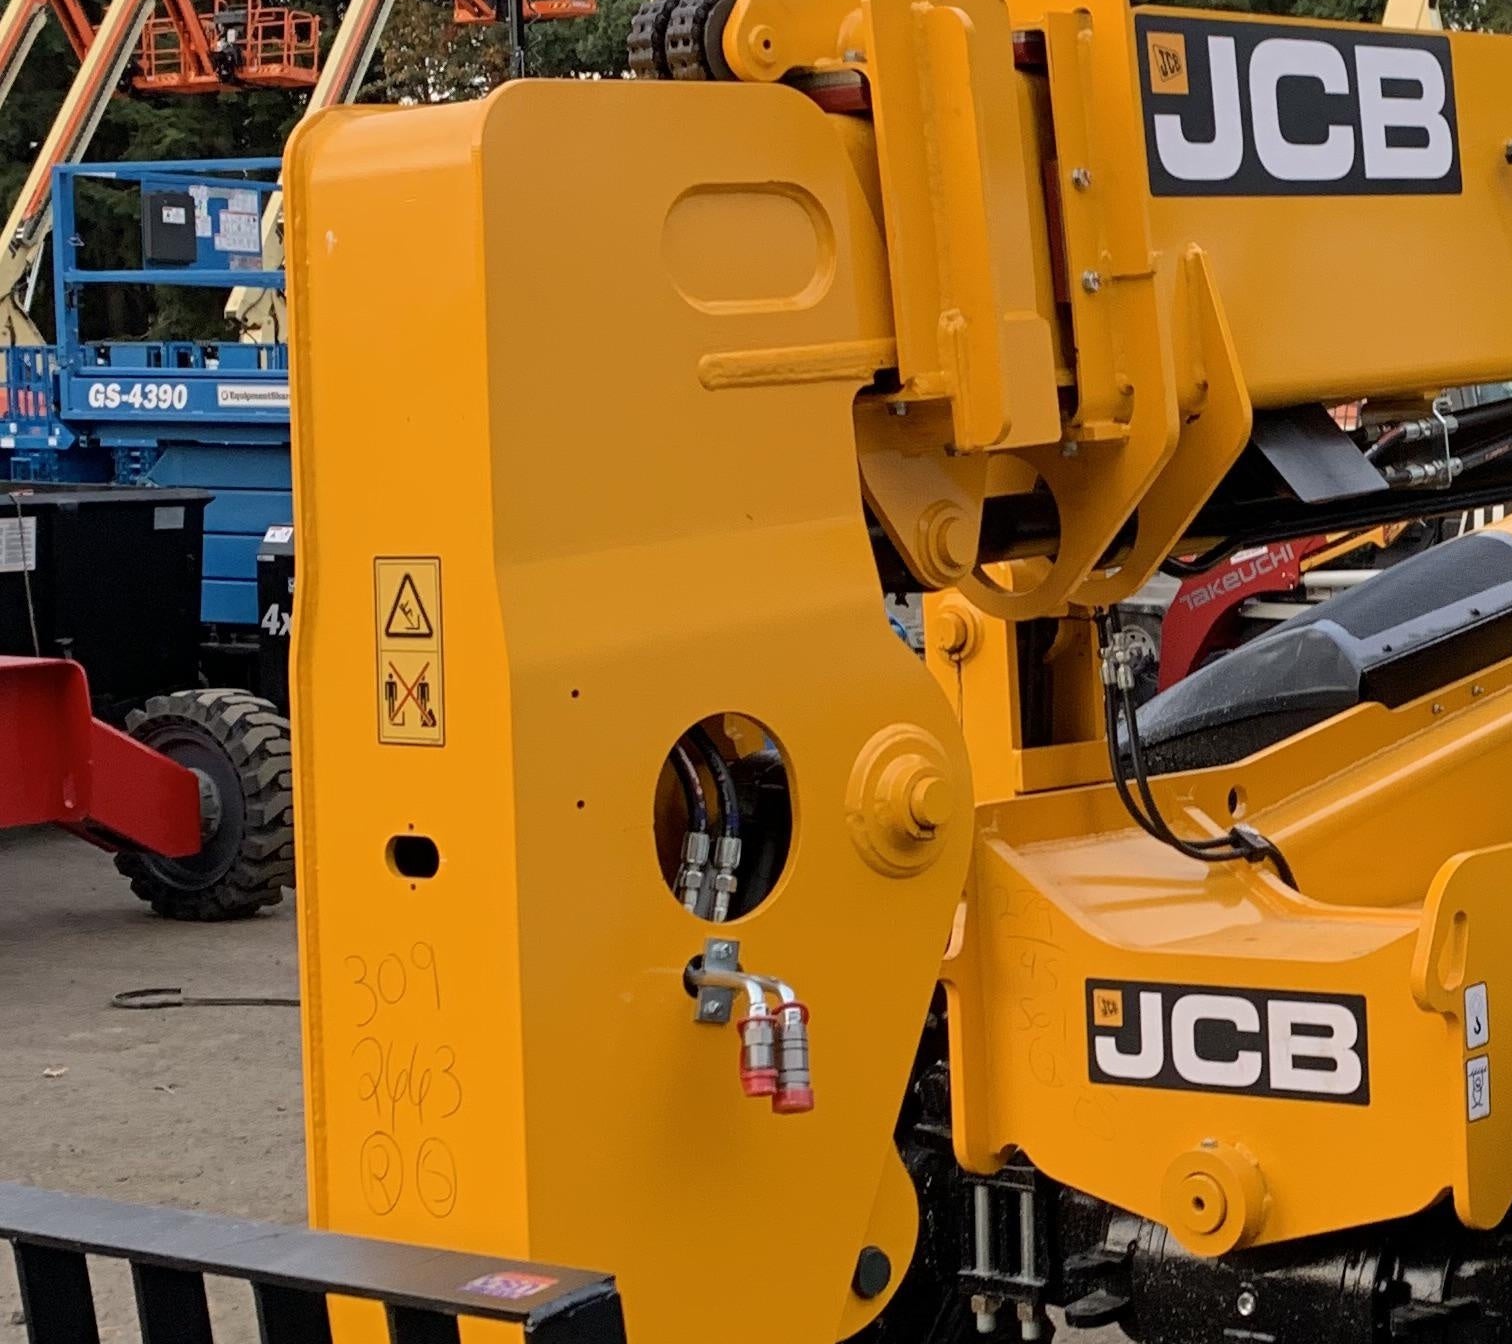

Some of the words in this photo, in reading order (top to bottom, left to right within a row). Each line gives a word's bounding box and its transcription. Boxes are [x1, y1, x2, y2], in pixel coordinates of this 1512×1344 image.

[1159, 50, 1182, 78] JCB
[1153, 35, 1453, 181] JCB
[88, 383, 188, 409] GS-4390
[344, 940, 440, 1027] 309
[1095, 991, 1362, 1094] JCB
